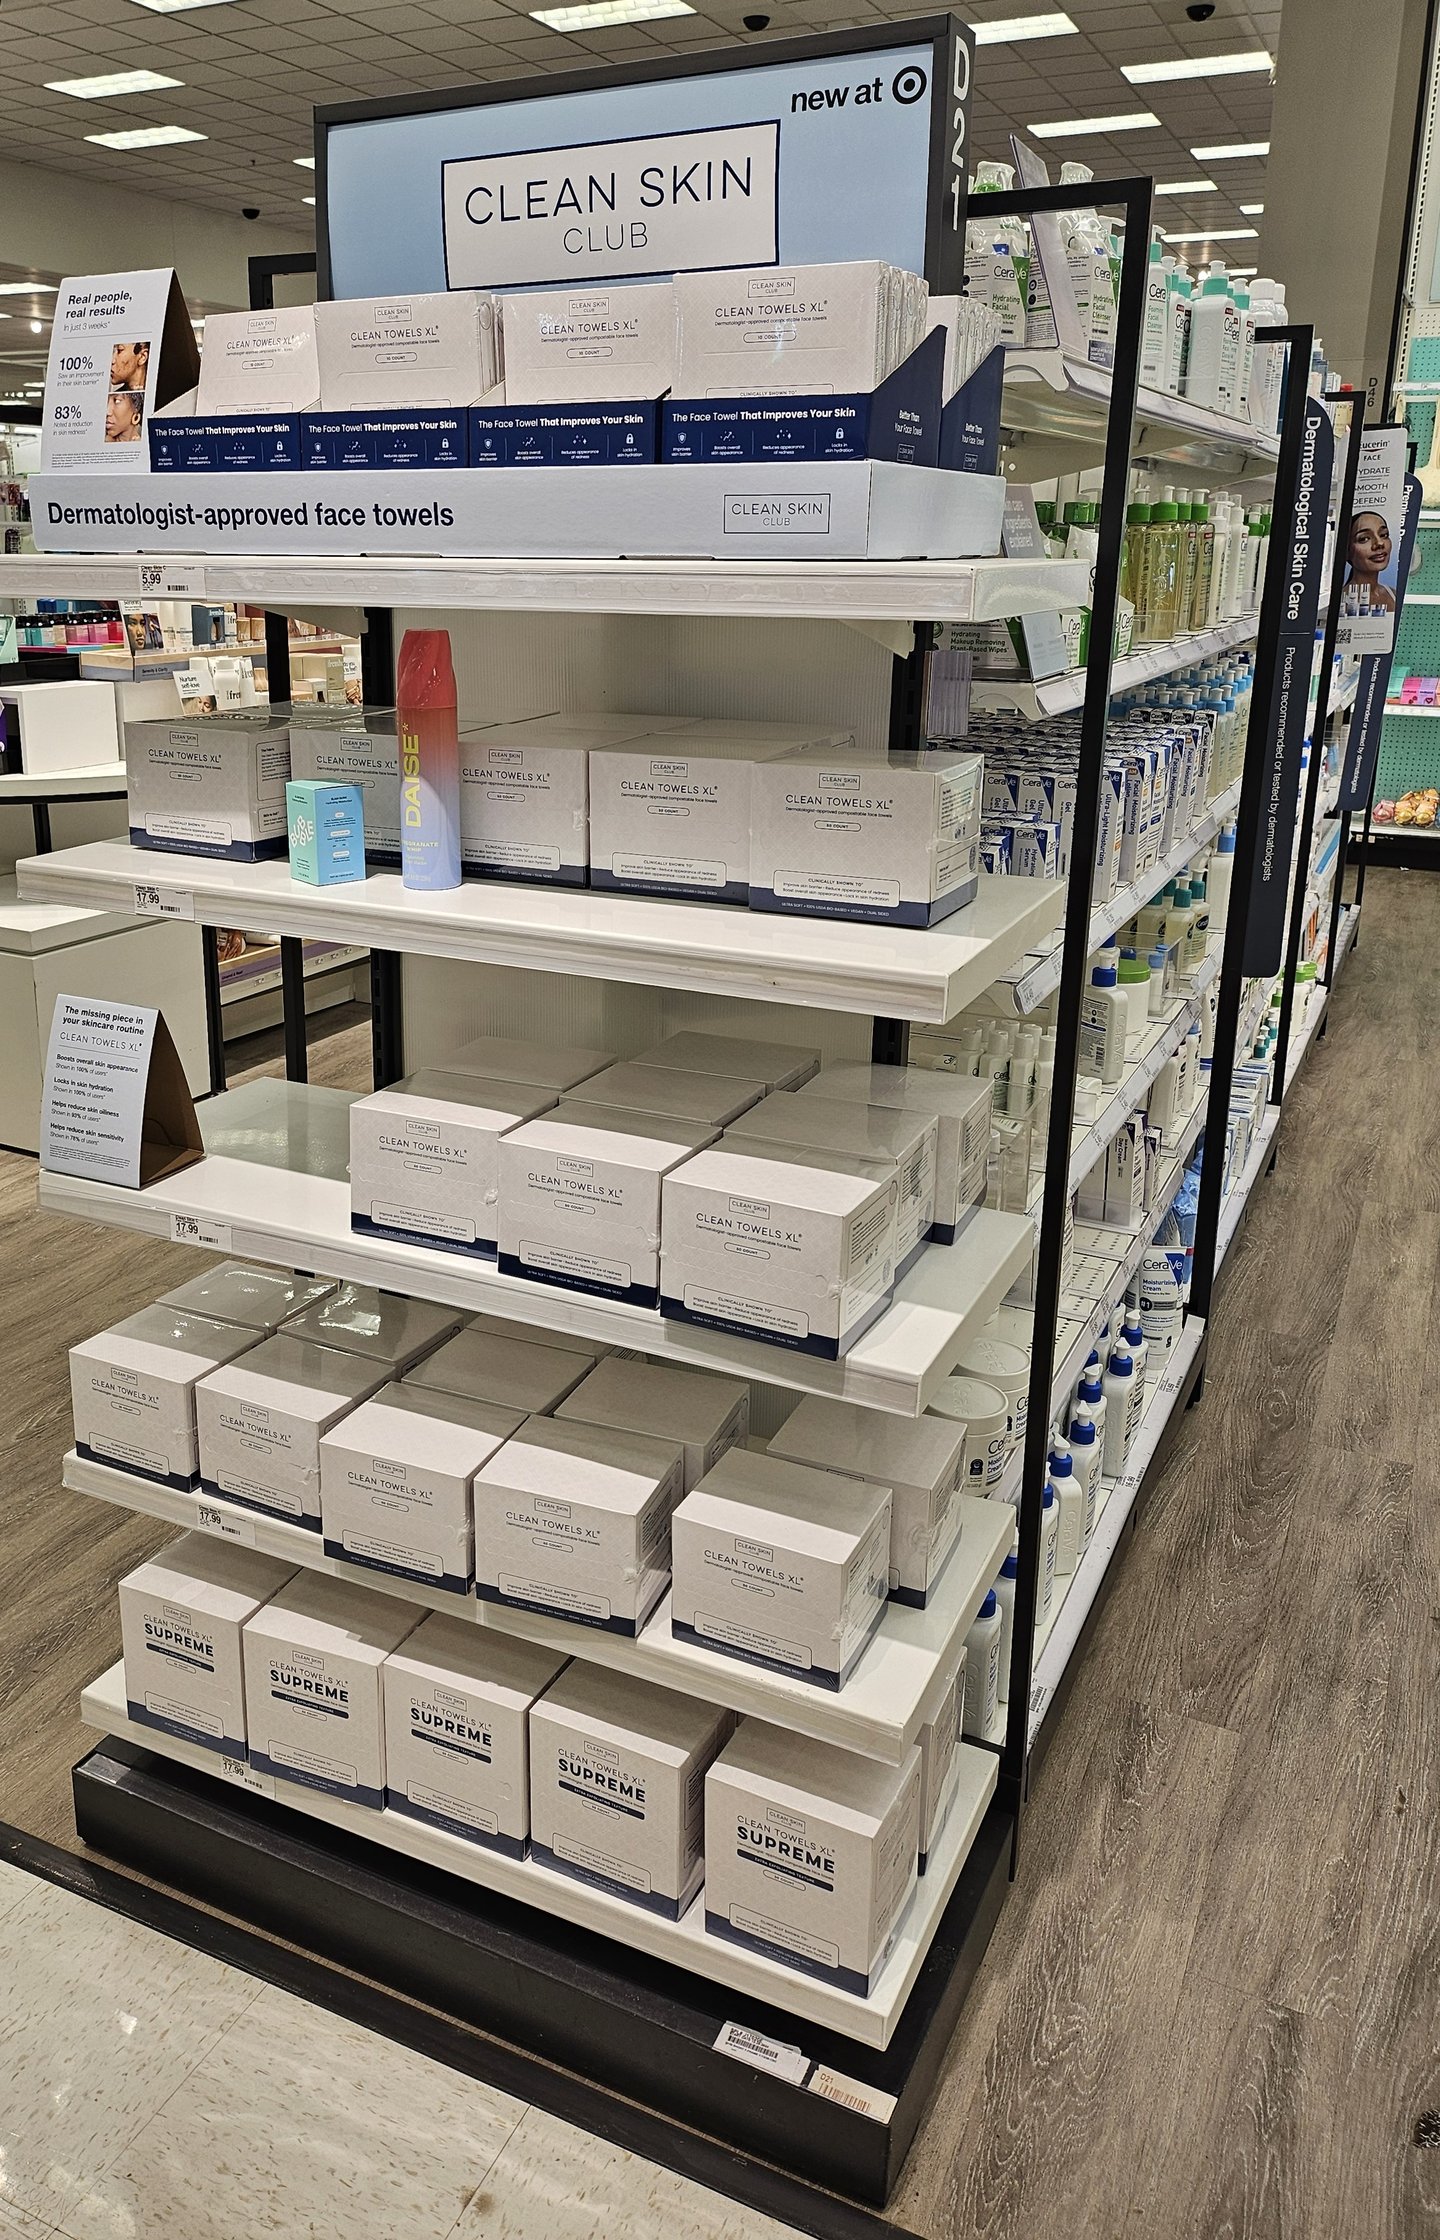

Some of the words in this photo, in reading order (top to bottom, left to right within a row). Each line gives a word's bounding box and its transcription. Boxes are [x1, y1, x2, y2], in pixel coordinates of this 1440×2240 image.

[790, 87, 848, 113] new
[854, 77, 883, 104] at
[465, 172, 616, 224] CLEAN
[639, 156, 752, 207] SKIN
[563, 222, 648, 254] CLUB
[994, 266, 1027, 279] CeraVe
[68, 293, 91, 305] Real
[94, 291, 132, 304] people,
[992, 294, 1020, 305] Hydrating
[66, 306, 86, 318] real
[89, 305, 125, 317] results
[715, 306, 753, 318] CLEAN
[758, 303, 806, 315] TOWELS
[71, 323, 82, 332] just
[351, 331, 381, 341] CLEAN
[385, 328, 422, 339] TOWELS
[60, 356, 93, 370] 100%
[55, 405, 81, 419] 83%
[673, 413, 687, 422] The
[690, 412, 710, 421] Face
[713, 411, 738, 421] Towel
[740, 410, 761, 420] That
[763, 410, 808, 421] Improves
[810, 408, 832, 418] Your
[834, 407, 855, 417] Skin
[479, 420, 492, 428] The
[494, 420, 513, 428] Face
[516, 418, 538, 427] Towel
[540, 418, 559, 426] That
[561, 417, 600, 427] Improves
[603, 416, 622, 425] Your
[624, 414, 643, 424] Skin
[1294, 416, 1321, 539] Dermatological
[1358, 467, 1390, 475] YDRATE
[48, 502, 308, 531] Dermatologist-approved
[314, 502, 366, 526] face
[372, 502, 454, 526] towels
[731, 503, 781, 515] CLEAN
[788, 503, 822, 514] SKIN
[763, 518, 790, 526] CLUB
[1291, 543, 1309, 578] Skin
[142, 573, 161, 585] 5.99
[1287, 582, 1304, 620] Care
[951, 638, 974, 647] Makeup
[976, 639, 1005, 647] Removing
[1283, 647, 1295, 689] Products
[1275, 690, 1288, 758] recommended
[1273, 761, 1281, 771] or
[1270, 772, 1281, 801] tested
[786, 795, 822, 804] CLEAN
[827, 797, 872, 808] TOWELS
[1267, 803, 1276, 813] by
[1262, 814, 1276, 882] dermatologists
[136, 893, 159, 904] 17.99
[65, 1006, 79, 1015] The
[81, 1008, 110, 1021] missing
[112, 1013, 134, 1023] piece
[62, 1016, 80, 1025] your
[82, 1019, 114, 1030] skincare
[116, 1024, 144, 1035] routine
[60, 1032, 89, 1043] CLEAN
[91, 1037, 126, 1050] TOWELS
[57, 1054, 75, 1062] Boosts
[107, 1063, 138, 1073] appearance
[89, 1083, 114, 1092] hydration
[52, 1100, 66, 1108] Helps
[68, 1102, 86, 1111] reduce
[99, 1109, 119, 1117] oiliness
[51, 1123, 65, 1131] Helps
[66, 1126, 84, 1134] reduce
[98, 1132, 124, 1142] sensitivity
[176, 1222, 198, 1234] 17.99
[696, 1213, 732, 1229] CLEAN
[737, 1221, 782, 1239] TOWELS
[1143, 1259, 1182, 1269] CeraVe
[199, 1511, 221, 1525] 17.99
[704, 1550, 738, 1566] CLEAN
[742, 1560, 784, 1580] TOWELS
[269, 1660, 297, 1674] CLEAN
[299, 1668, 333, 1685] TOWELS
[270, 1669, 349, 1703] SUPREME
[223, 1762, 244, 1776] 17.99
[737, 1815, 770, 1833] CLEAN
[775, 1829, 816, 1851] TOWELS
[737, 1826, 834, 1874] SUPREME
[820, 2073, 833, 2083] D21
